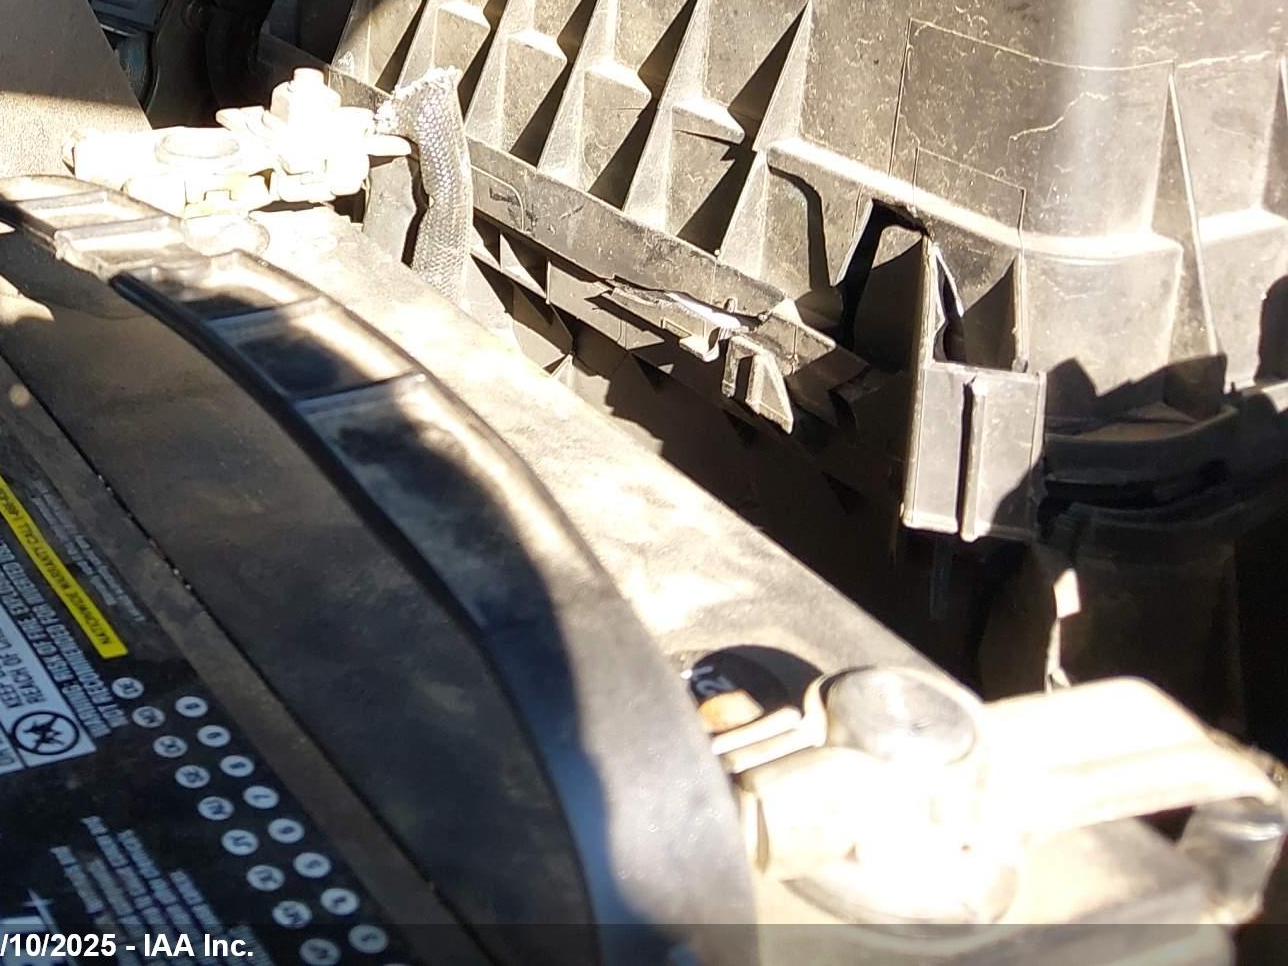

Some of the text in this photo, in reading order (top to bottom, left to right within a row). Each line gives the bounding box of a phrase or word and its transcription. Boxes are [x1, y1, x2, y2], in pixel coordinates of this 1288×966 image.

[14, 522, 40, 544] CALL
[32, 545, 73, 590] WARRANTY
[7, 666, 47, 705] REACH
